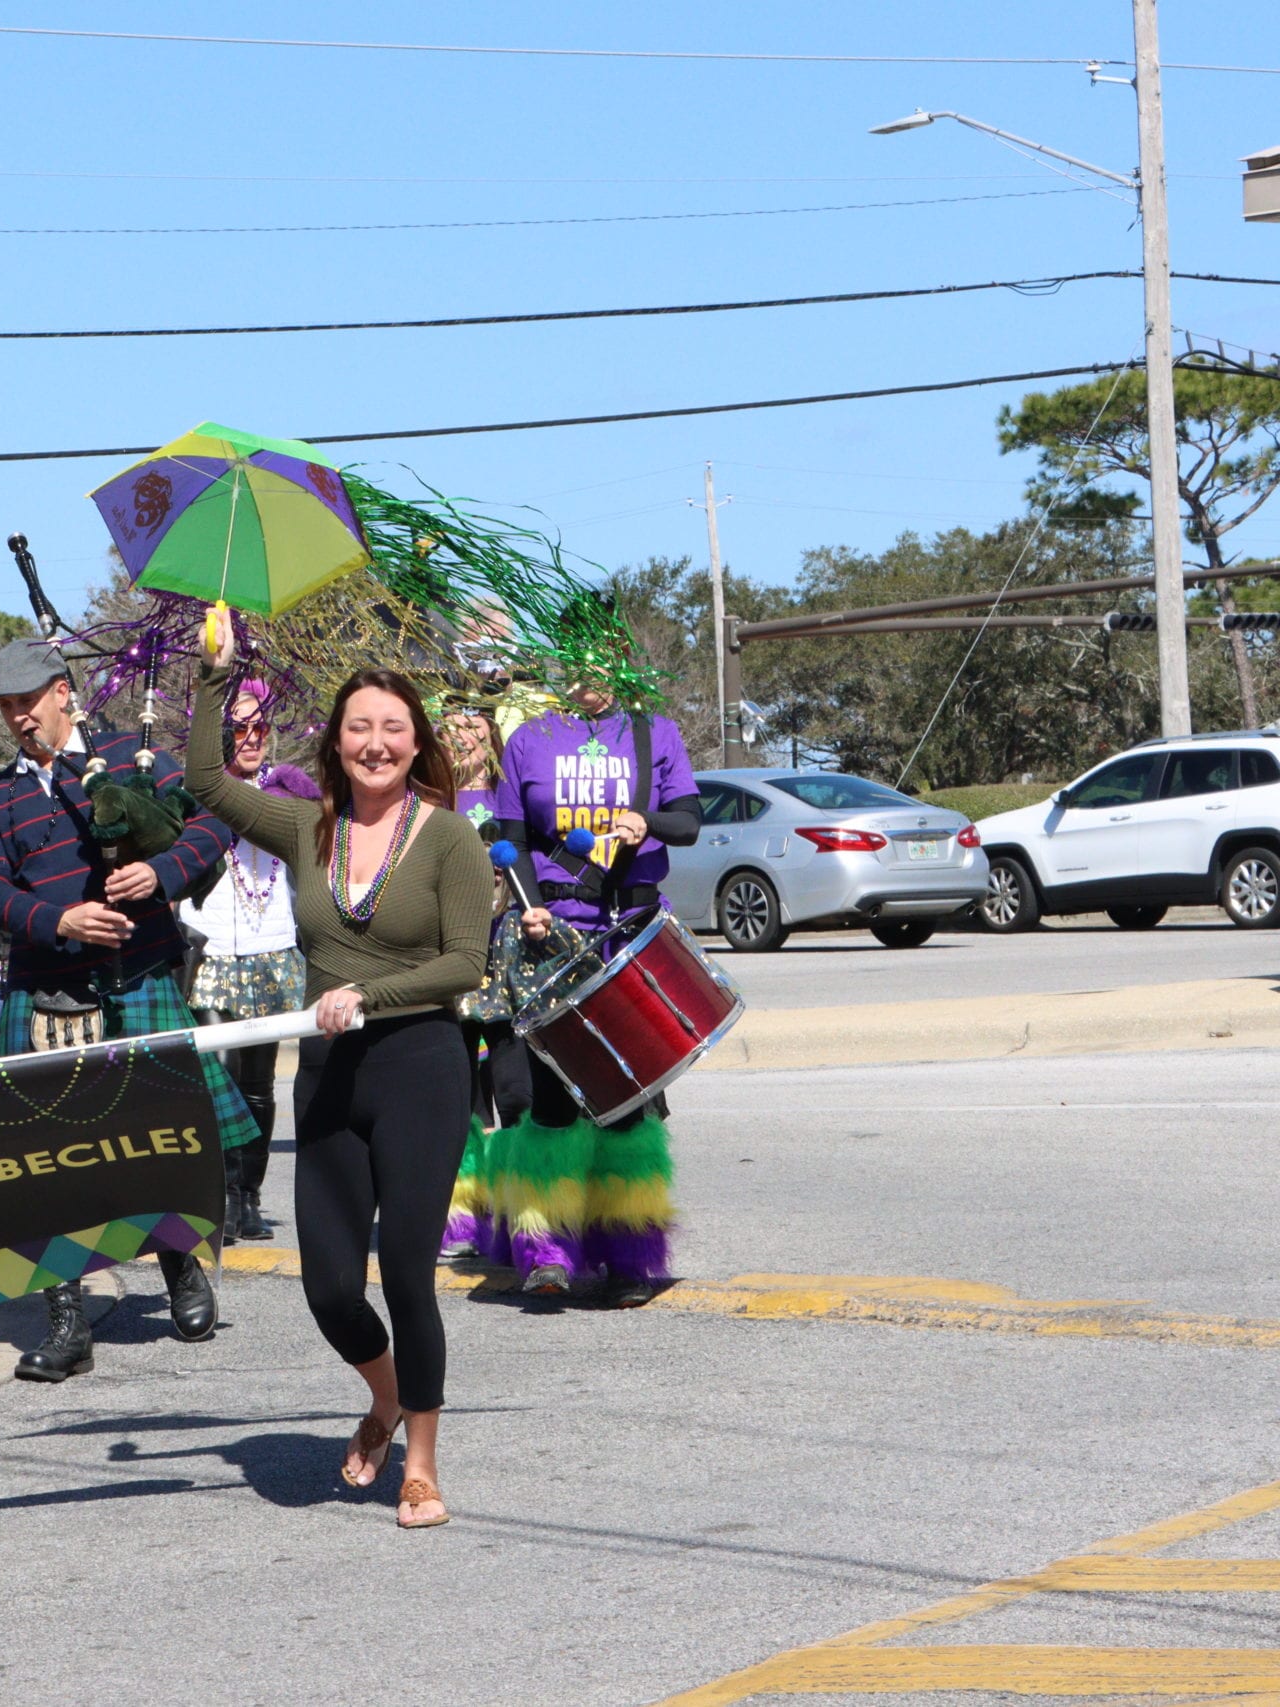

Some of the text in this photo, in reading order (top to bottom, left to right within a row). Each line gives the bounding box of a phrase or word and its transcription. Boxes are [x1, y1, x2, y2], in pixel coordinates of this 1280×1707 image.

[555, 755, 631, 778] MARDI
[555, 779, 630, 806] LIKE A
